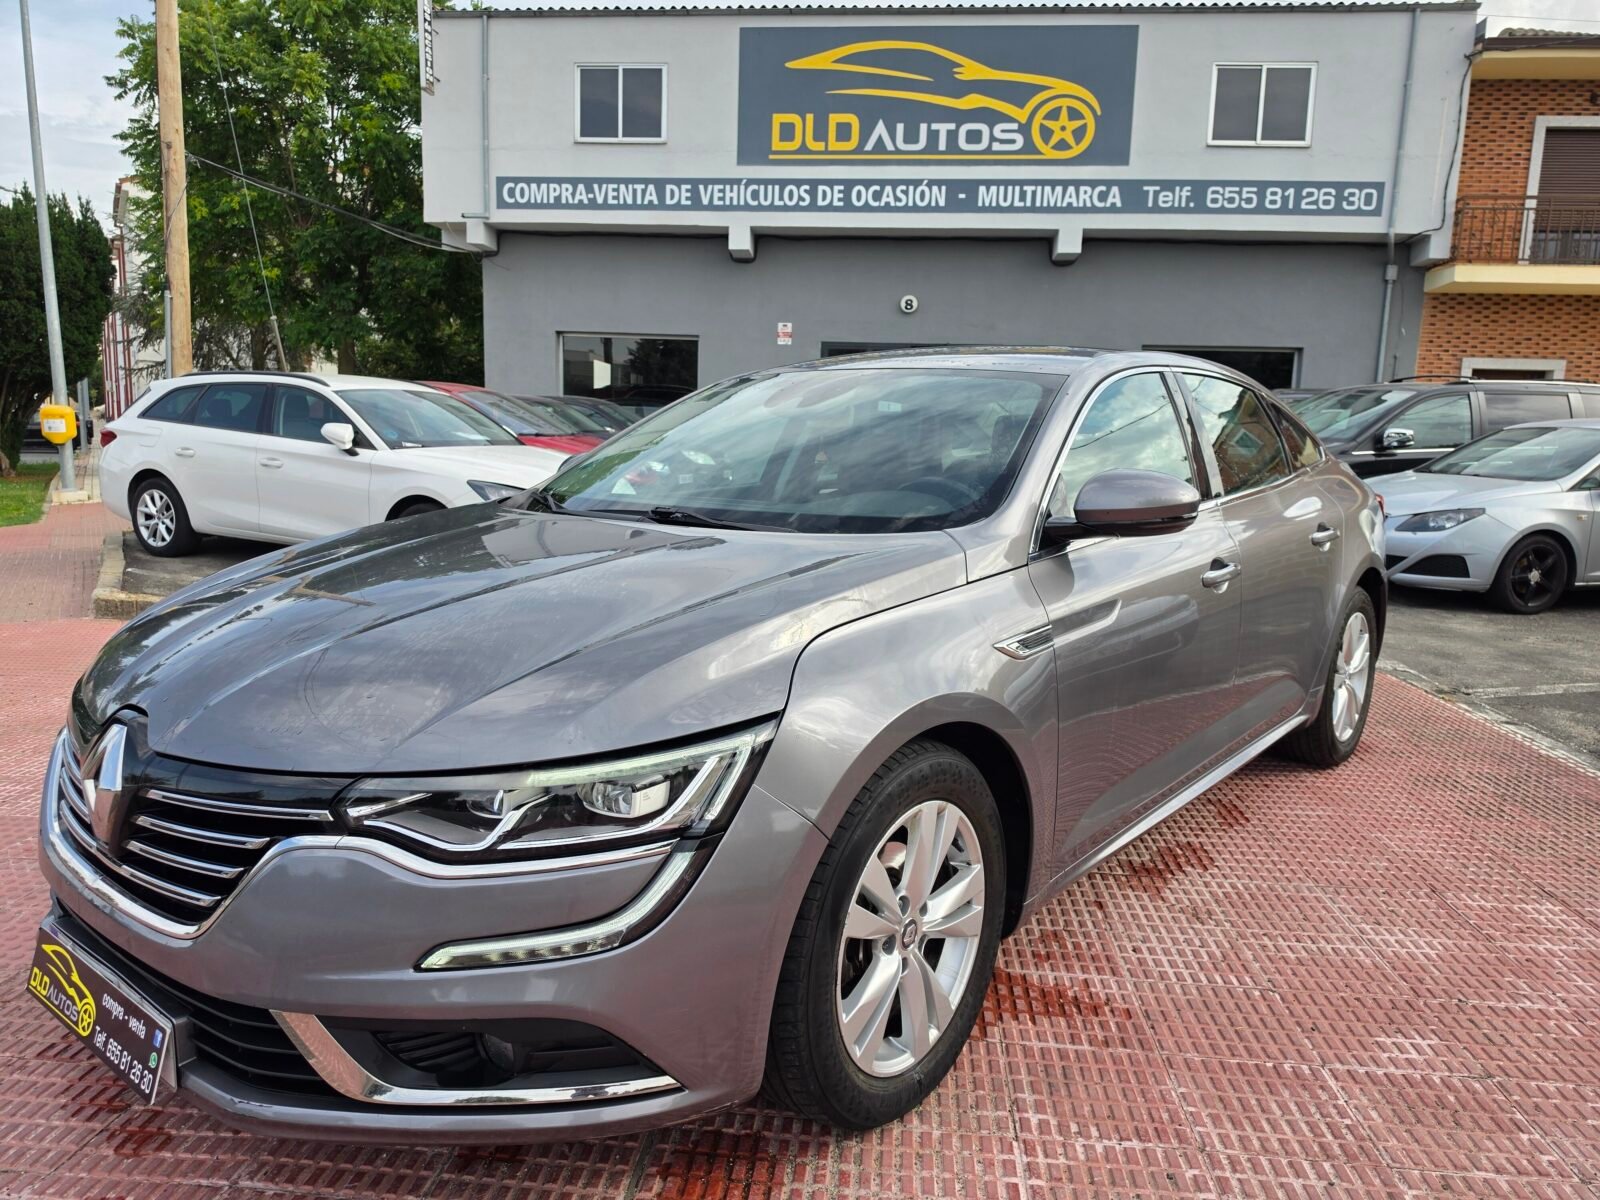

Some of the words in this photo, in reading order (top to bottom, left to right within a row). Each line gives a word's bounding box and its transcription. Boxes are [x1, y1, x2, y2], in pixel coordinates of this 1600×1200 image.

[771, 113, 860, 151] DLD
[863, 118, 1025, 151] AUTOS
[502, 182, 659, 205] COMPRA-VENTA
[665, 184, 692, 205] DE
[698, 179, 811, 207] VEHÍCULOS
[816, 185, 845, 206] DE
[851, 180, 947, 207] OCASIÓN
[977, 186, 1122, 208] MULTIMARCA
[1143, 186, 1195, 208] Telf.
[1206, 186, 1258, 209] 655
[1342, 188, 1378, 211] 30
[904, 299, 914, 310] 8
[46, 984, 79, 1022] AUTOS
[102, 993, 124, 1020] compra
[128, 1015, 146, 1039] venta
[93, 1025, 107, 1051] Telf.
[106, 1038, 122, 1064] 655
[120, 1051, 132, 1073] 81
[130, 1060, 143, 1084] 26
[141, 1070, 153, 1094] 30
